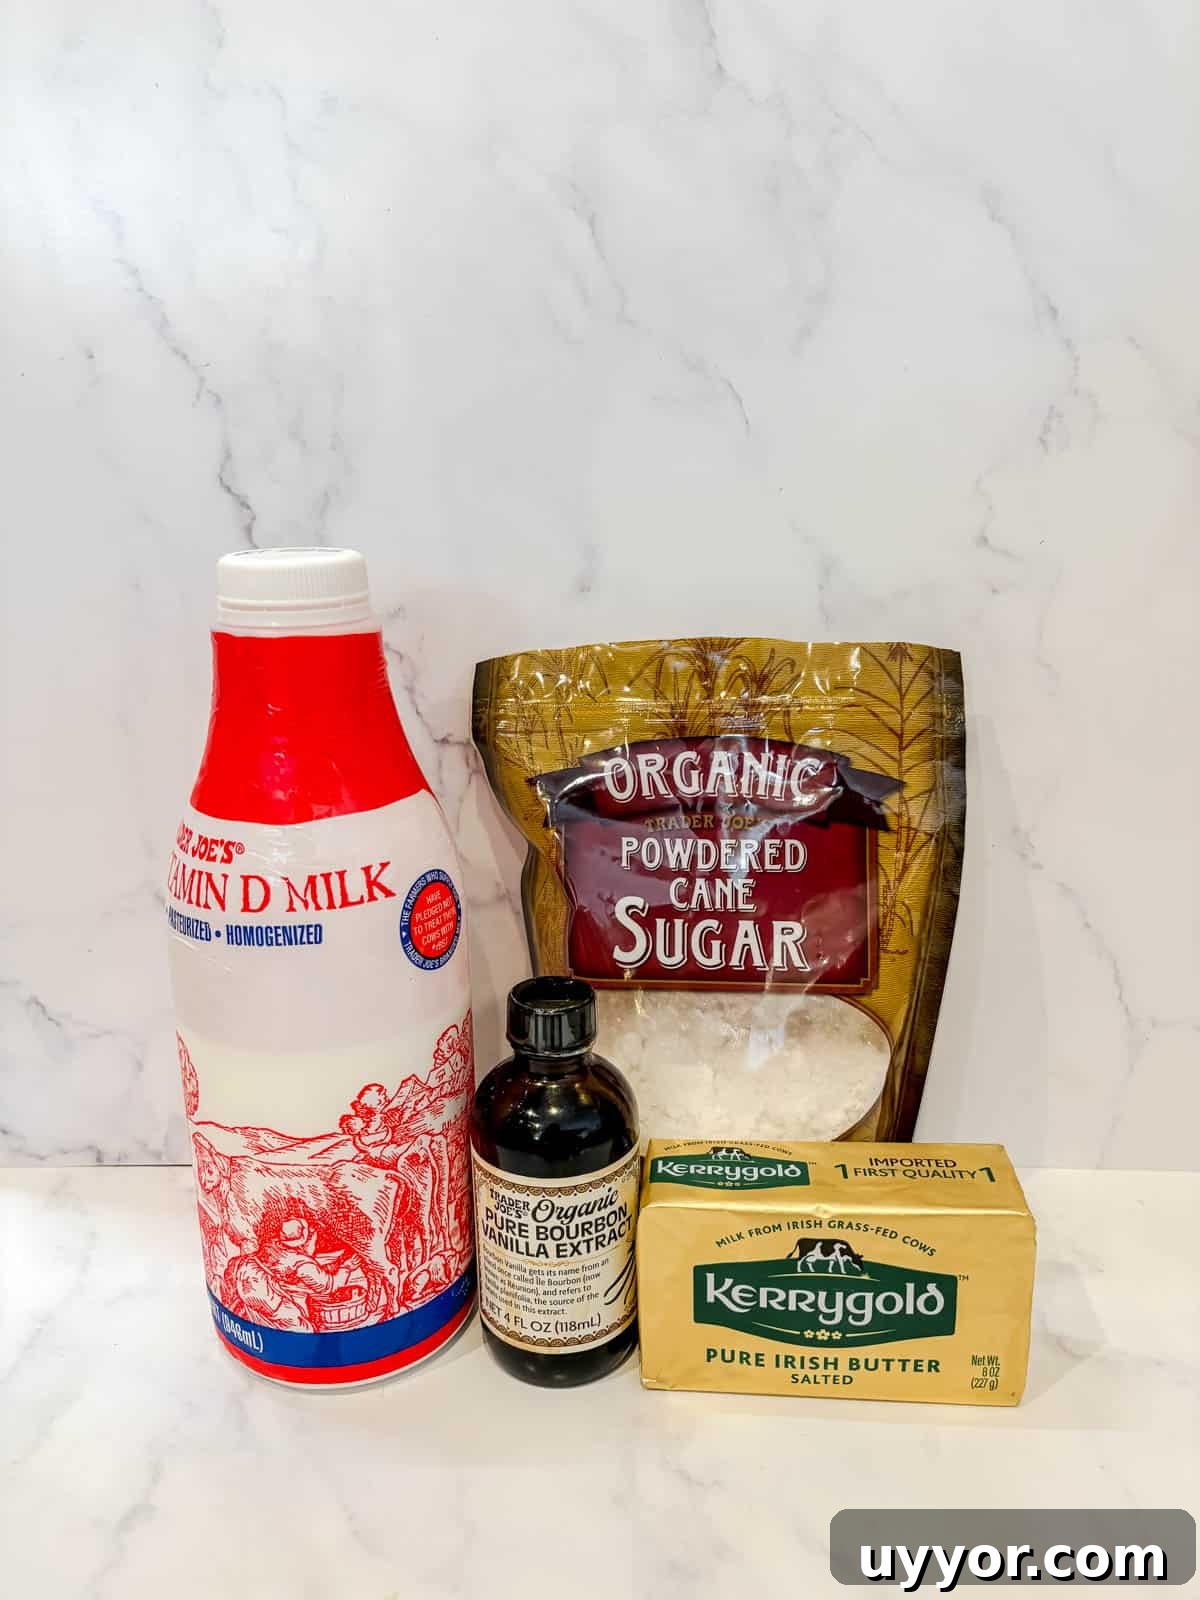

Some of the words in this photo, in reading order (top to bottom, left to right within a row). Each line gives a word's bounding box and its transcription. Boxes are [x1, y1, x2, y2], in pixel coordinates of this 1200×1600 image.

[604, 751, 821, 803] ORGANIC
[644, 814, 714, 832] TRADER
[620, 837, 807, 873] POWDERED
[240, 874, 271, 913] D
[281, 861, 399, 913] MILK
[669, 878, 757, 912] CANE
[225, 923, 323, 947] HOMOGENIZED
[613, 895, 812, 970] SUGAR
[853, 1168, 898, 1177] FIRST
[903, 1168, 977, 1180] QUALITY
[868, 1157, 957, 1168] IMPORTED
[490, 1188, 530, 1211] TRADER
[531, 1188, 618, 1225] Organic
[486, 1207, 529, 1238] PURE
[536, 1202, 627, 1241] BOURBON
[482, 1219, 549, 1259] VANILLA
[556, 1215, 632, 1258] EXTRACT
[716, 1231, 744, 1248] MILK
[748, 1224, 782, 1238] FROM
[787, 1220, 822, 1230] IRISH
[828, 1219, 898, 1240] GRASS-FED
[901, 1235, 937, 1257] COWS
[529, 1268, 544, 1277] gets
[546, 1268, 556, 1277] its
[558, 1267, 580, 1276] name
[581, 1262, 599, 1273] from
[542, 1287, 557, 1296] and
[503, 1313, 510, 1323] 4
[514, 1315, 528, 1329] FL
[530, 1320, 552, 1333] OZ
[554, 1312, 601, 1334] (118mL)
[706, 1348, 765, 1367] PURE
[774, 1353, 839, 1371] IRISH
[848, 1357, 941, 1373] BUTTER
[971, 1354, 985, 1366] Net
[988, 1367, 1000, 1377] OZ
[790, 1373, 853, 1385] SALTED
